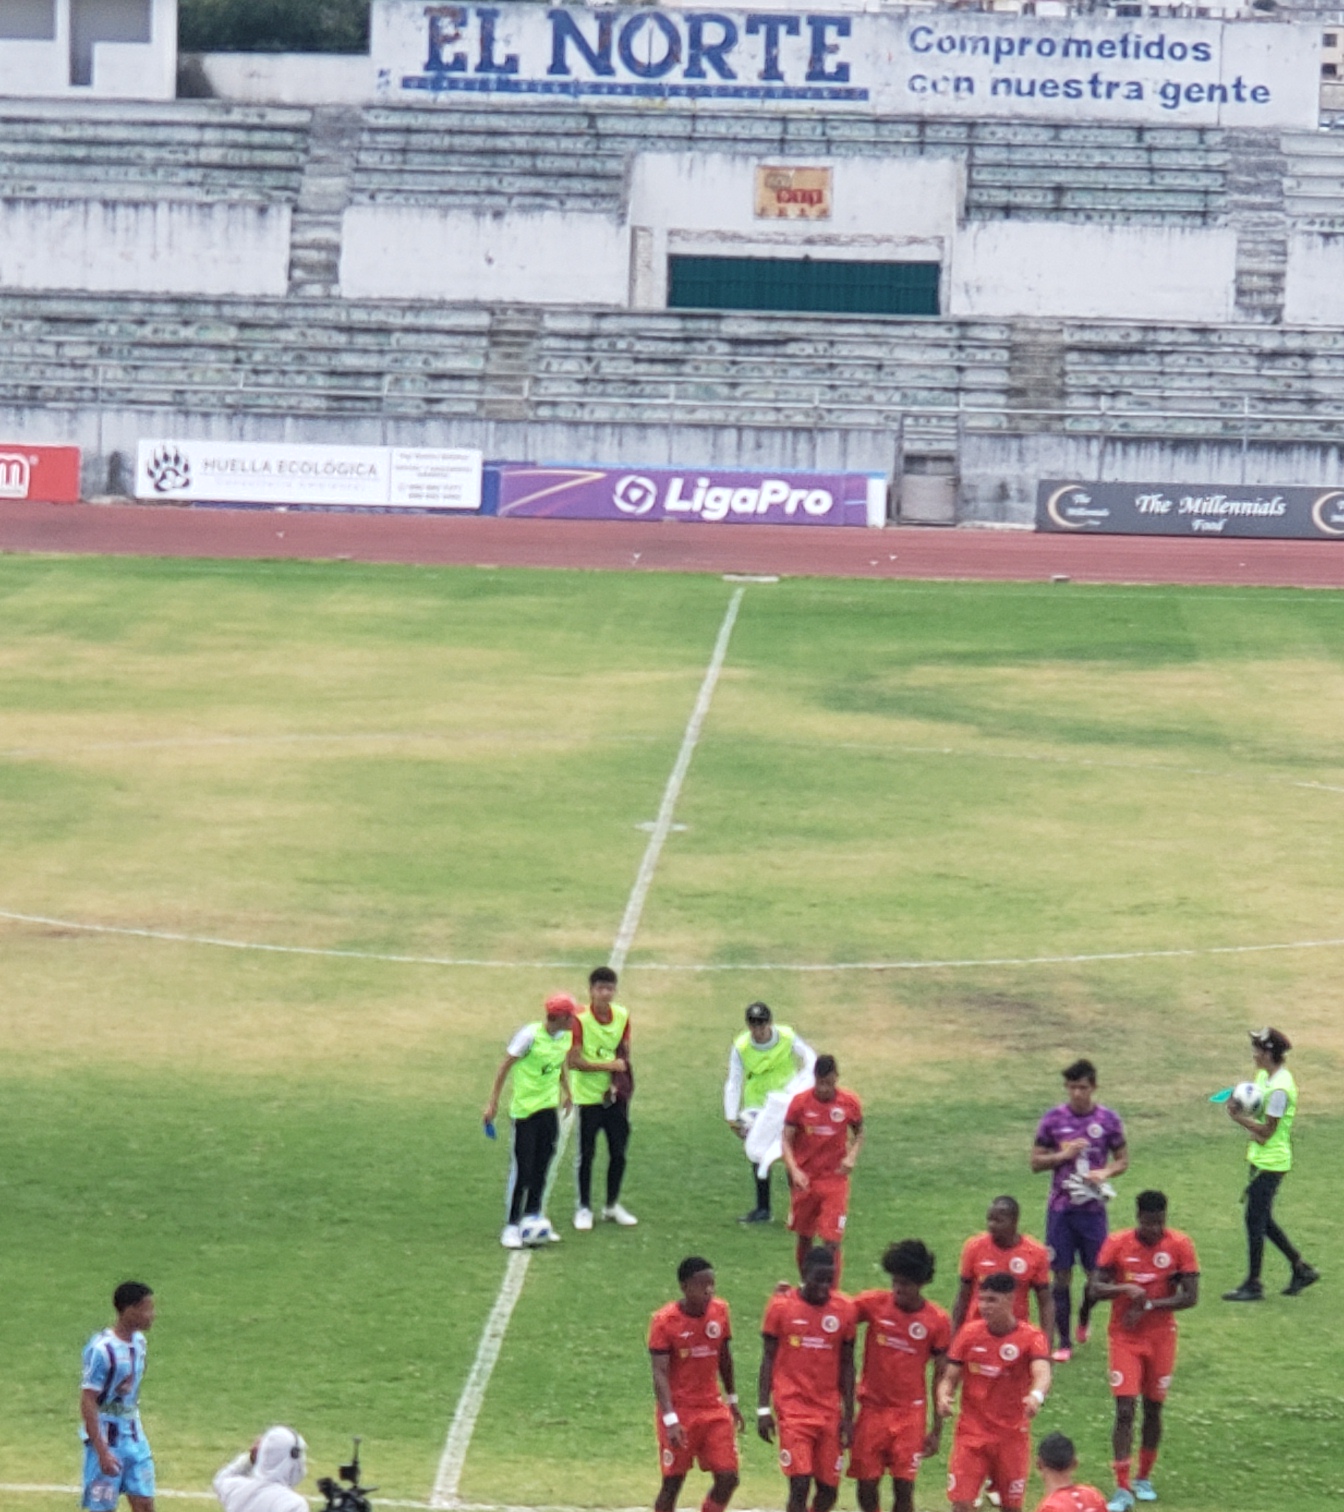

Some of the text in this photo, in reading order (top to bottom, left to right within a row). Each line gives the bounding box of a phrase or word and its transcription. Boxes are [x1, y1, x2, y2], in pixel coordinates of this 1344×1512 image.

[423, 5, 853, 83] EL NORTE
[908, 26, 1213, 64] Comprometidos
[991, 71, 1145, 101] nuestra
[1159, 75, 1272, 109] gente
[204, 458, 272, 474] HUELLA
[277, 459, 378, 477] ECOLÓGICA
[663, 477, 834, 521] LigaPro
[1134, 493, 1288, 517] The Millennials
[1191, 517, 1227, 532] Food
